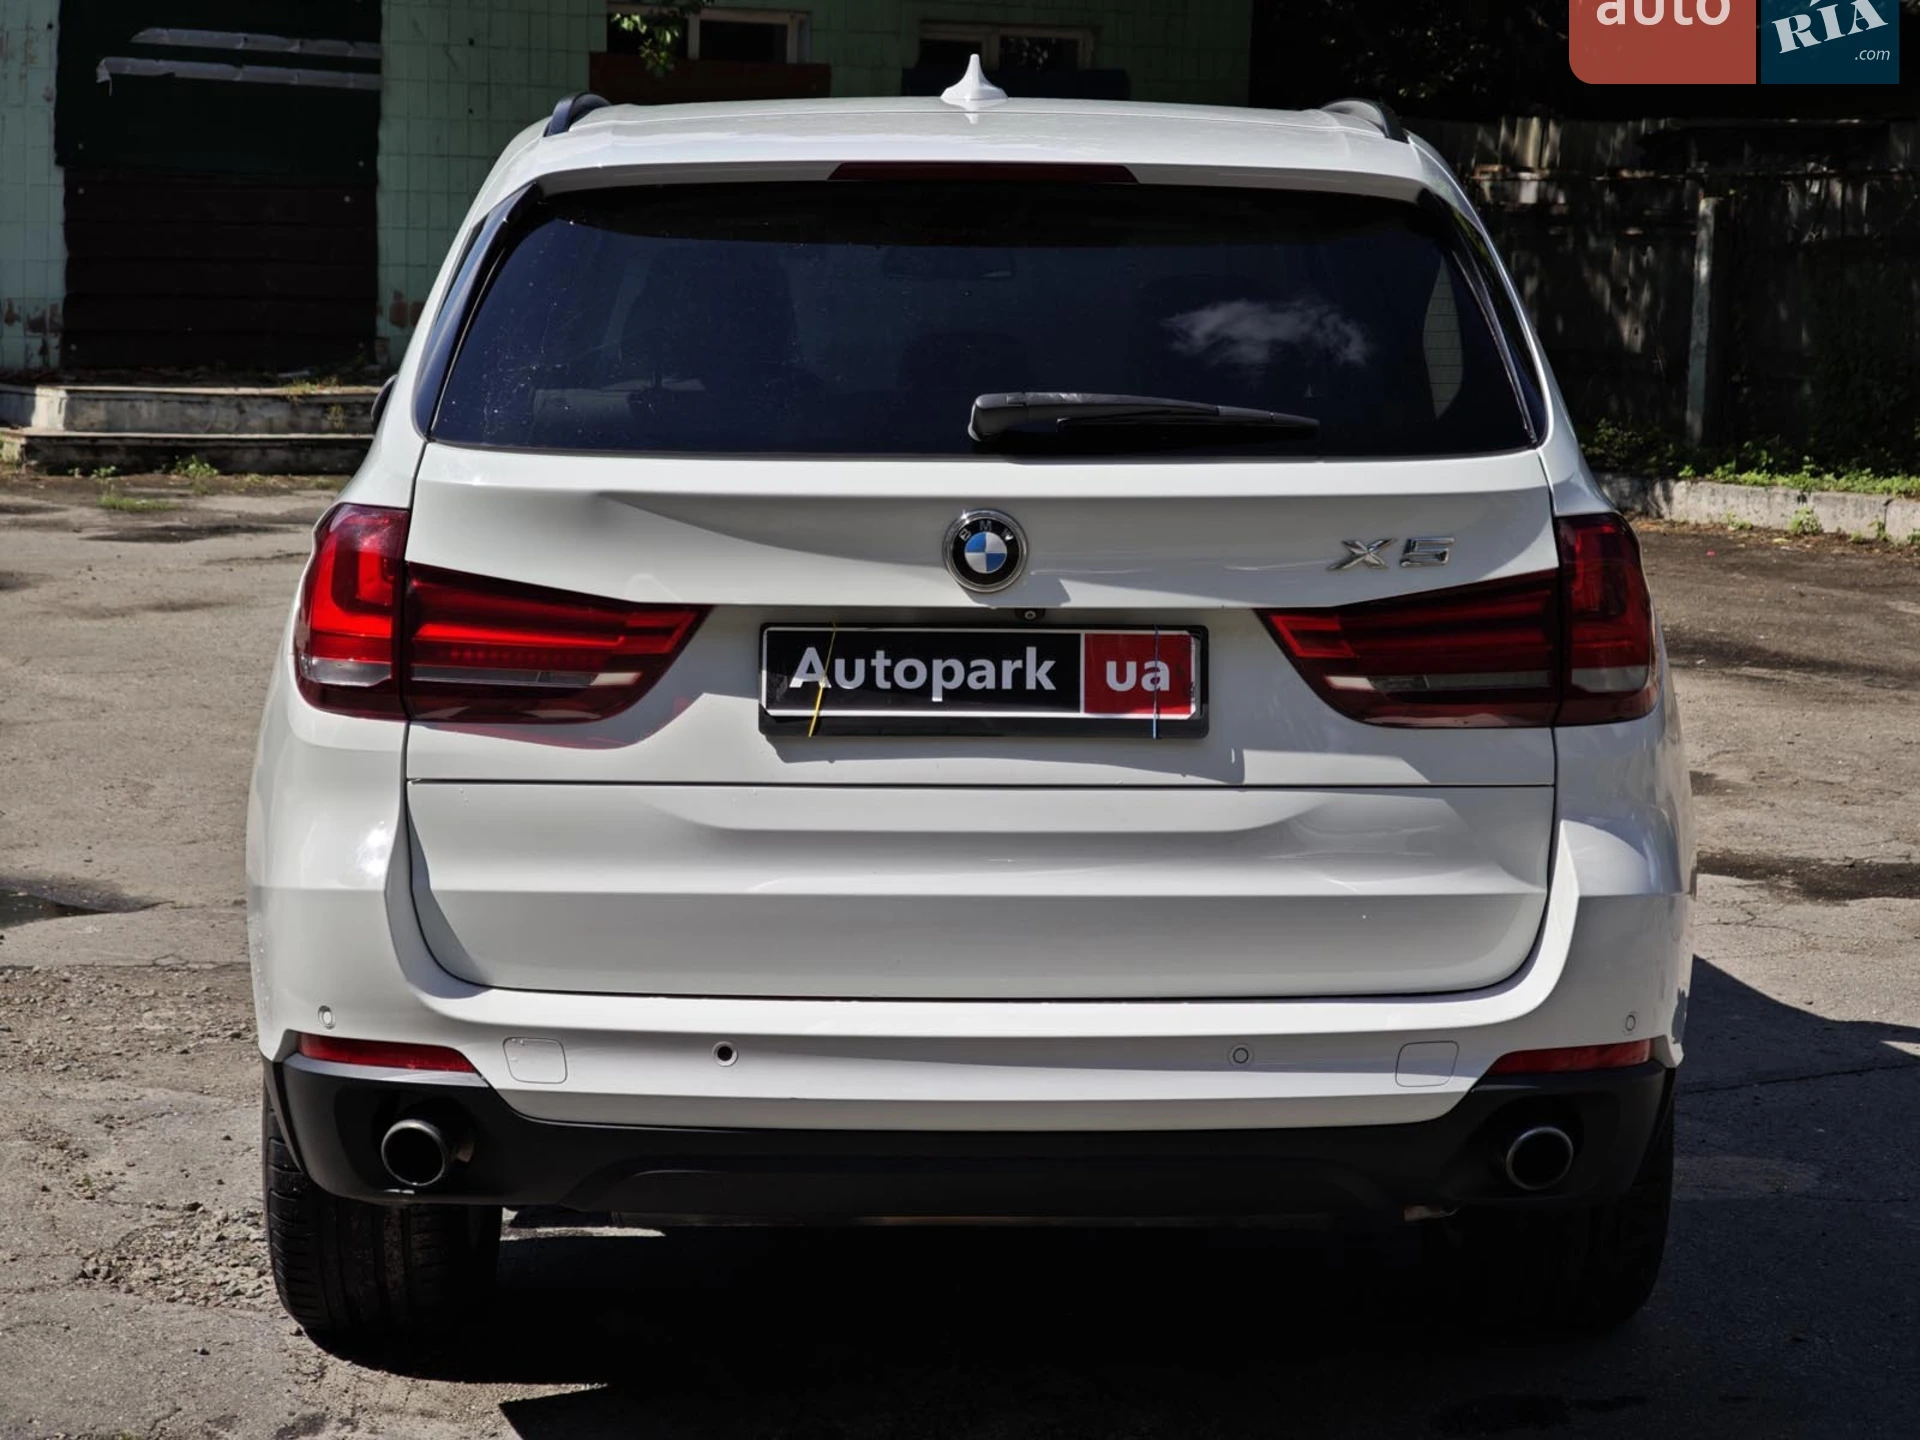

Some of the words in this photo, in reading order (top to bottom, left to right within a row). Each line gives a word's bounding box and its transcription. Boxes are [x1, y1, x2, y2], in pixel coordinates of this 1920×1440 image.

[958, 519, 1014, 542] BMW
[789, 646, 1057, 702] Autopark
[1105, 660, 1171, 692] ua
